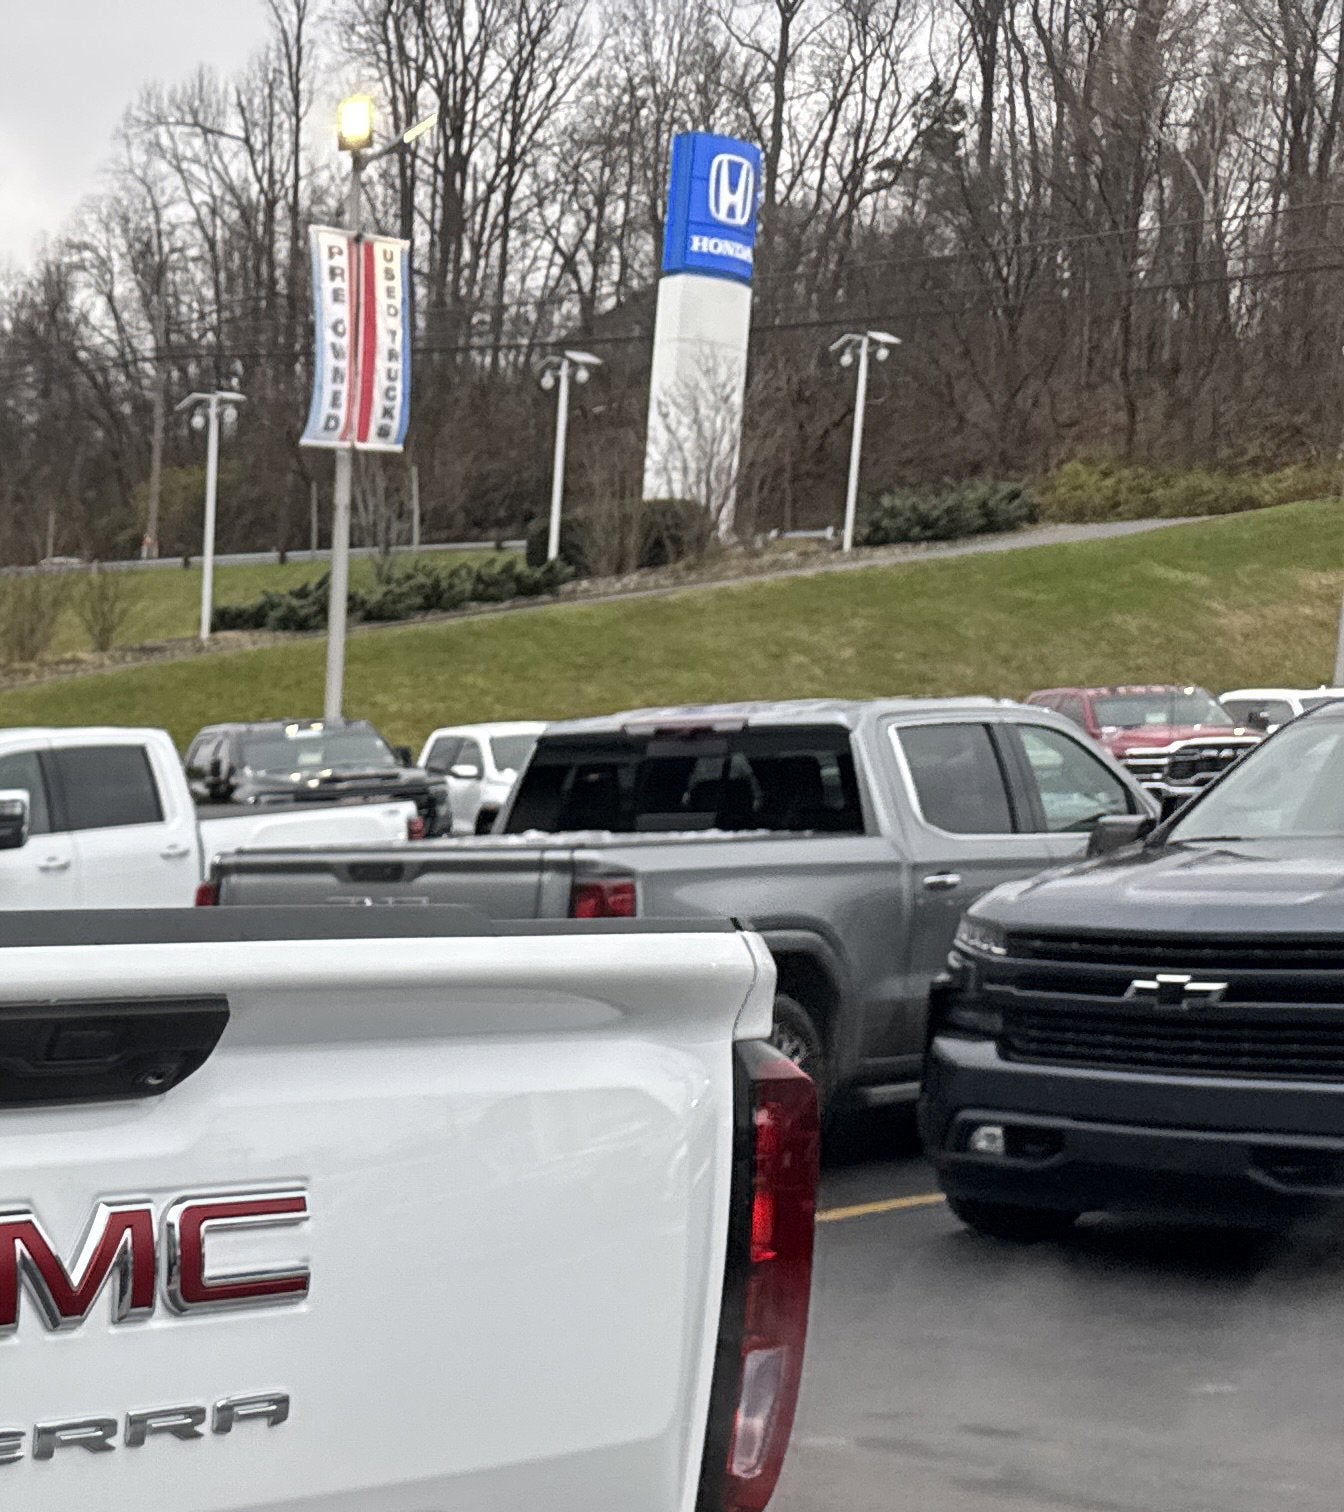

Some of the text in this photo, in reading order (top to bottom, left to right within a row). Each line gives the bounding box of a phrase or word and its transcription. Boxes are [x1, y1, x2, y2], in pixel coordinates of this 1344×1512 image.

[324, 245, 346, 432] PRE OWNED
[377, 248, 399, 438] USED TRUCKS
